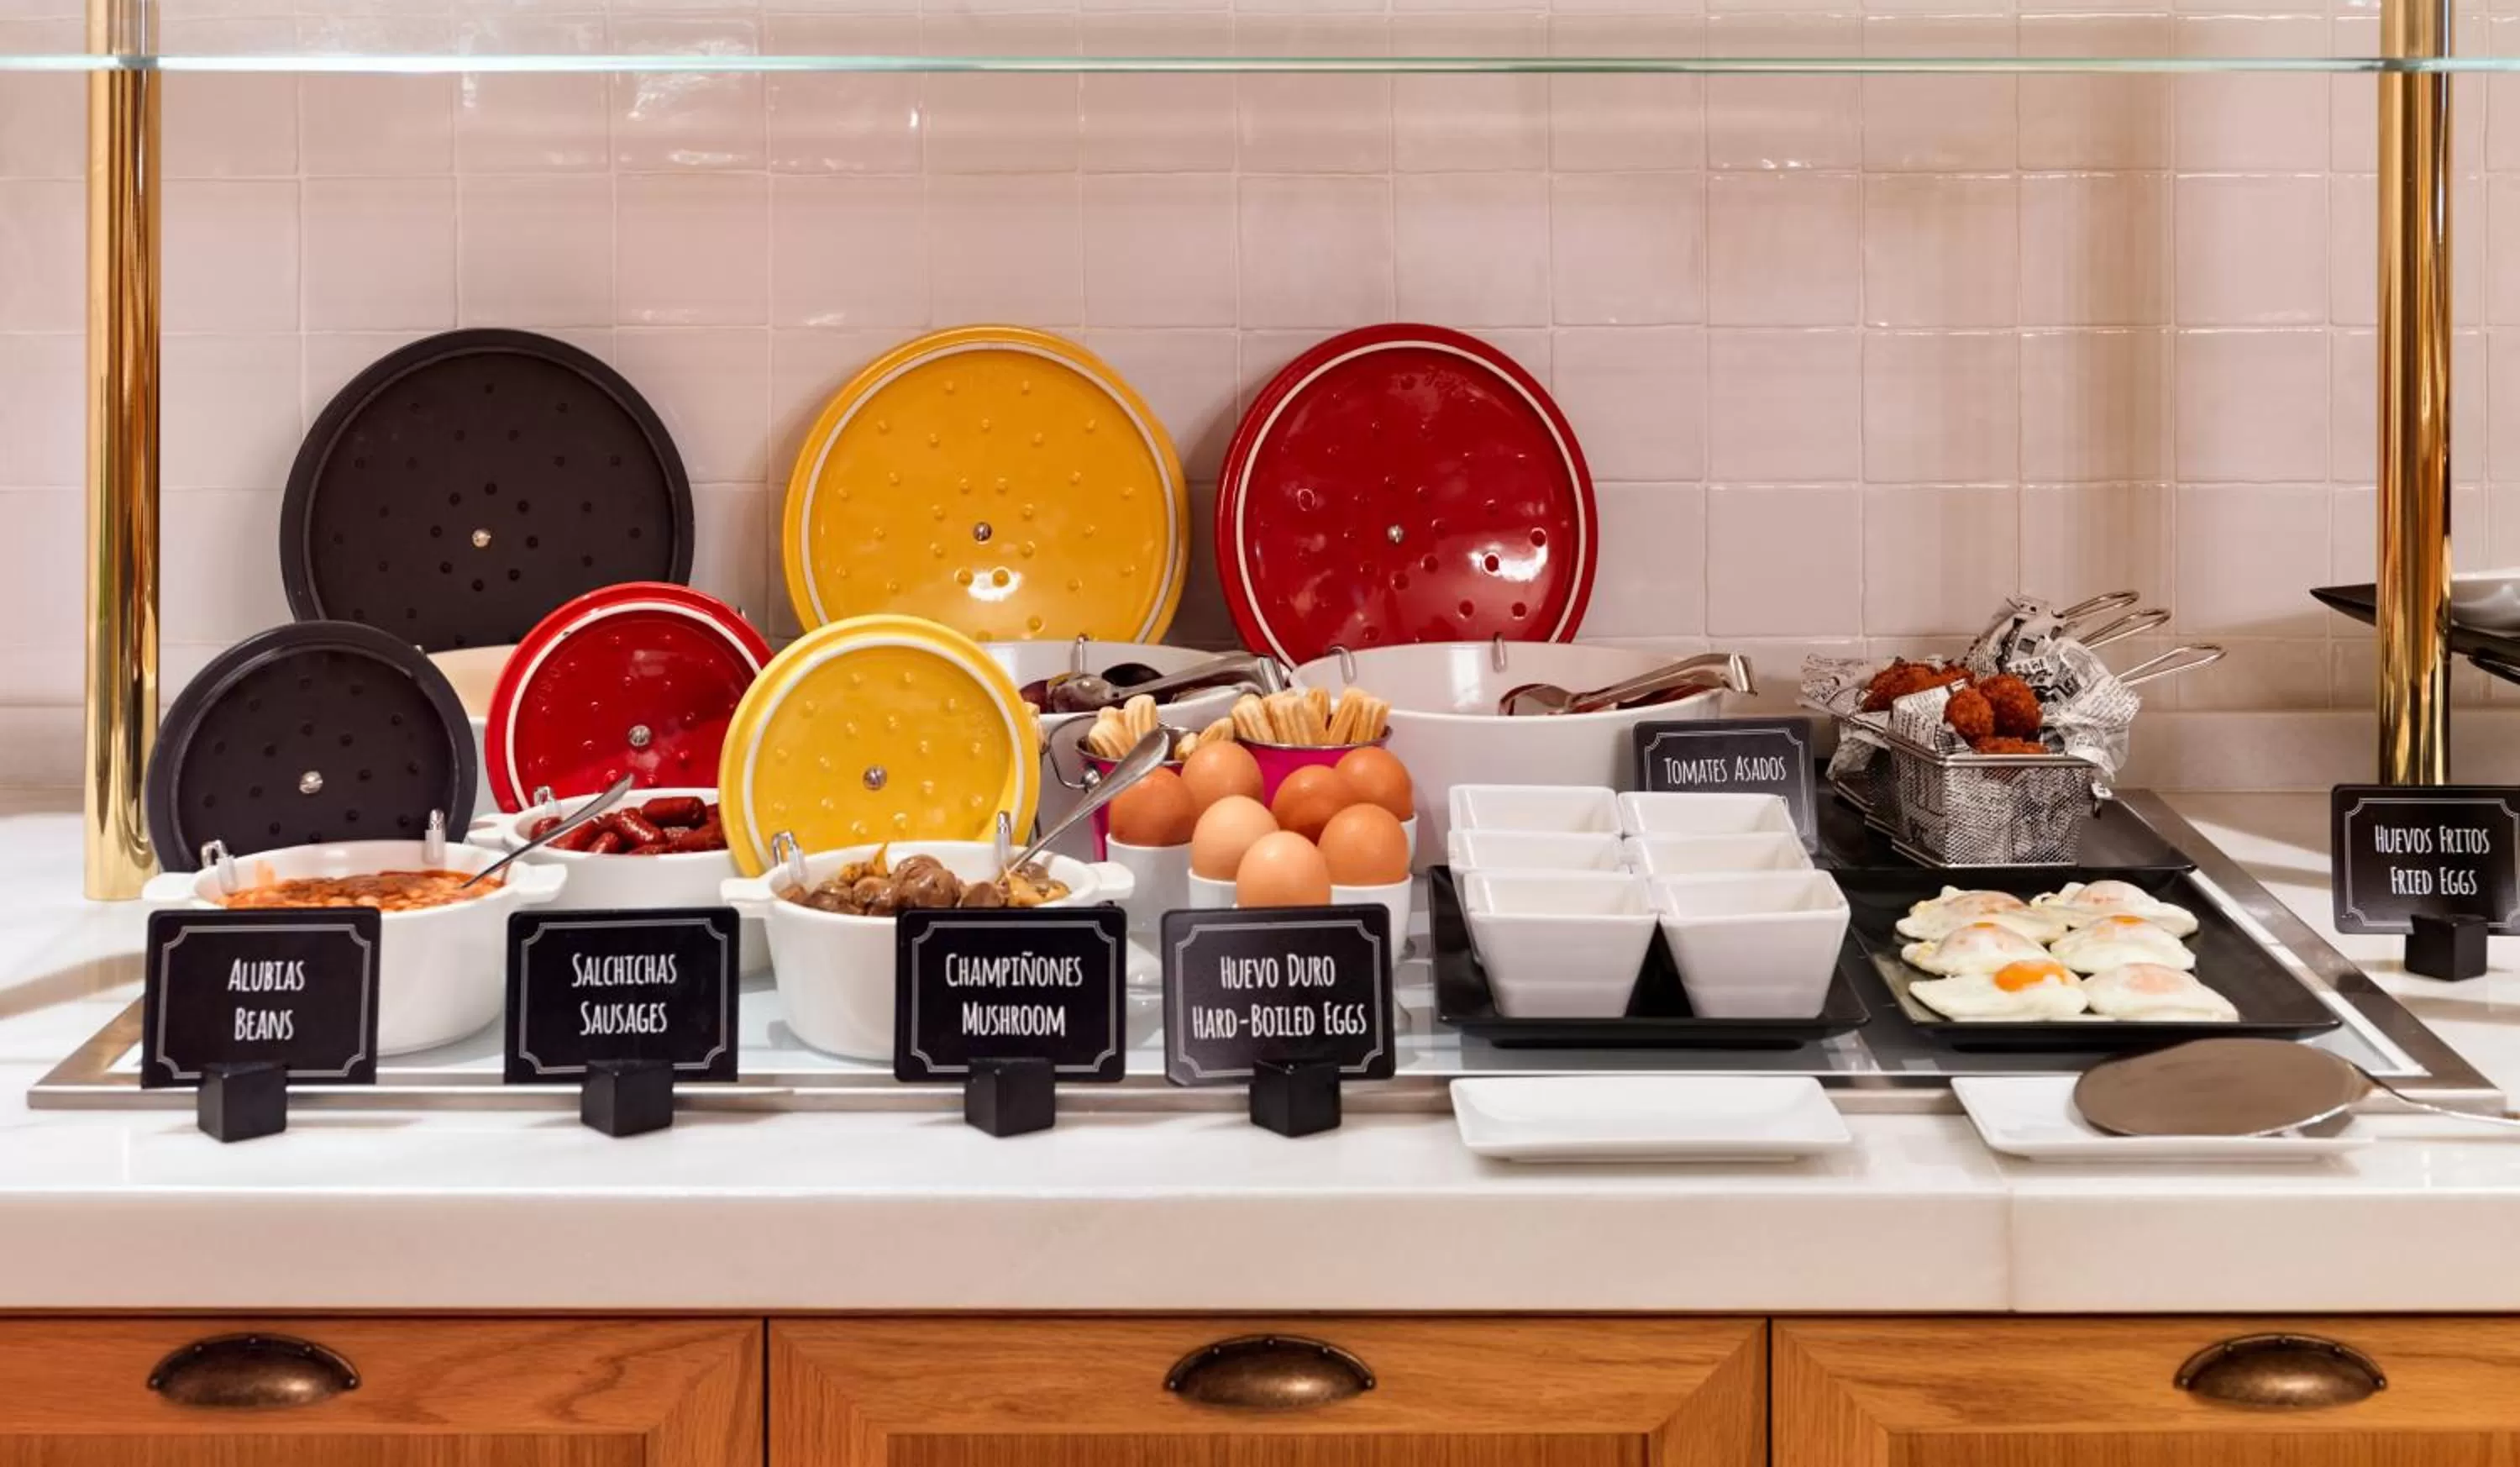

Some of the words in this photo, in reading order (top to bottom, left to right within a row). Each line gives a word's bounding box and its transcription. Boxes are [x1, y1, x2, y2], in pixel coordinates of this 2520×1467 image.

[1664, 757, 1728, 786] TOMATES
[1734, 755, 1787, 782] ASADOS
[2375, 824, 2433, 854] HUEVOS
[2439, 825, 2491, 854] FRITOS
[2390, 865, 2433, 896] FRIED
[2439, 866, 2477, 896] EGGS
[228, 958, 305, 992] ALUBIAS
[571, 952, 678, 988] SALCHICHAS
[945, 950, 1083, 989] CHAMPIÑONES
[1220, 955, 1279, 990] HUEVO
[1286, 953, 1336, 987] DURO
[234, 1007, 294, 1041] BEANS
[580, 1001, 668, 1036] SAUSAGES
[962, 1001, 1066, 1037] MUSHROOM
[1192, 1003, 1315, 1040] HARD-BOILED
[1323, 1001, 1367, 1035] EGGS
